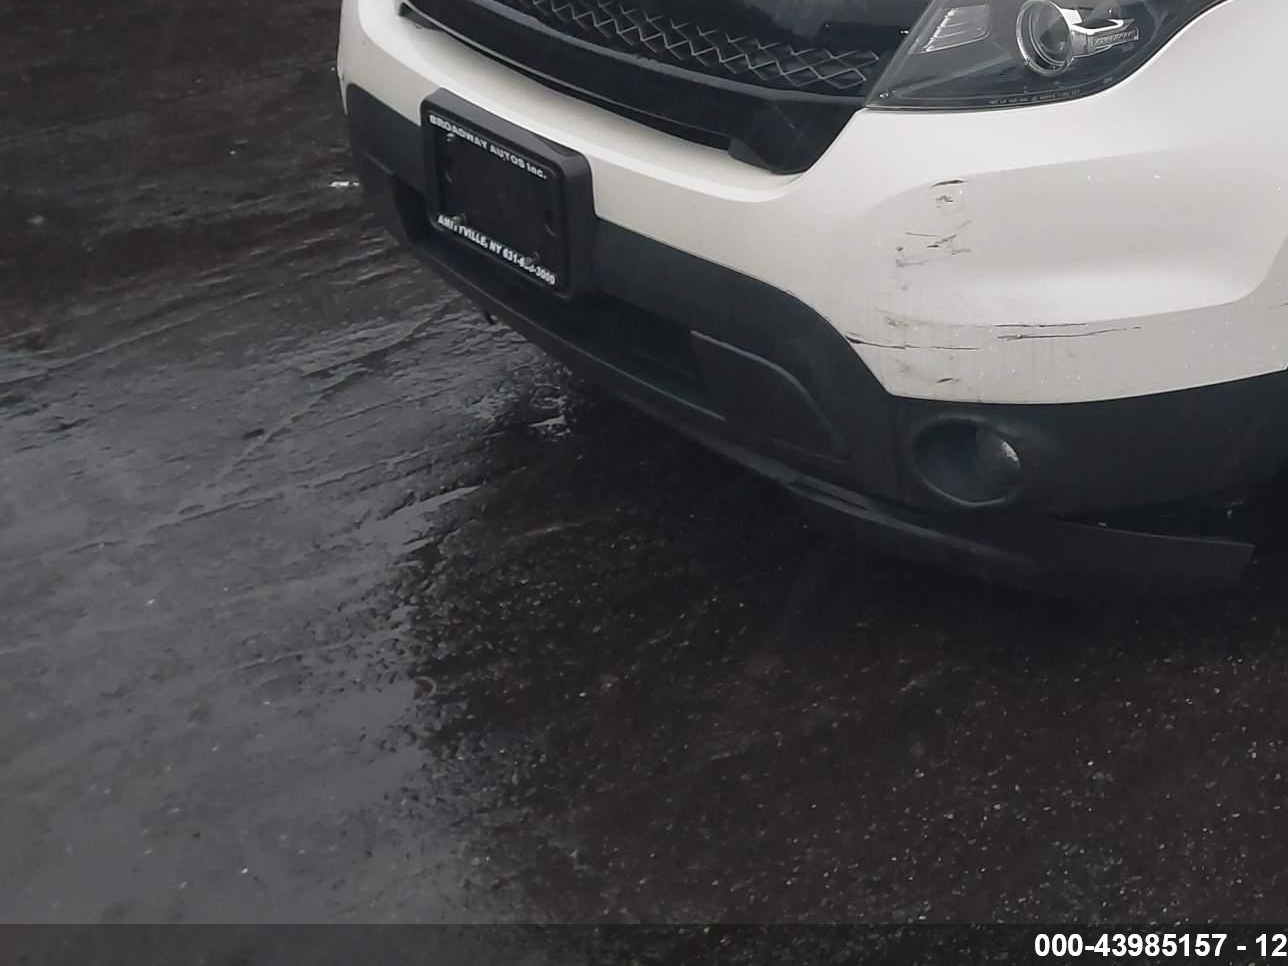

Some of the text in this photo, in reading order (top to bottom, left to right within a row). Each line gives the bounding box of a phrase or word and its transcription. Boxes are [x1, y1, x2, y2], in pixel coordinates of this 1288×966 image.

[429, 114, 548, 179] BROADWAY AUTOS Inc.
[489, 240, 502, 254] NY
[502, 248, 556, 285] 631-6-3000
